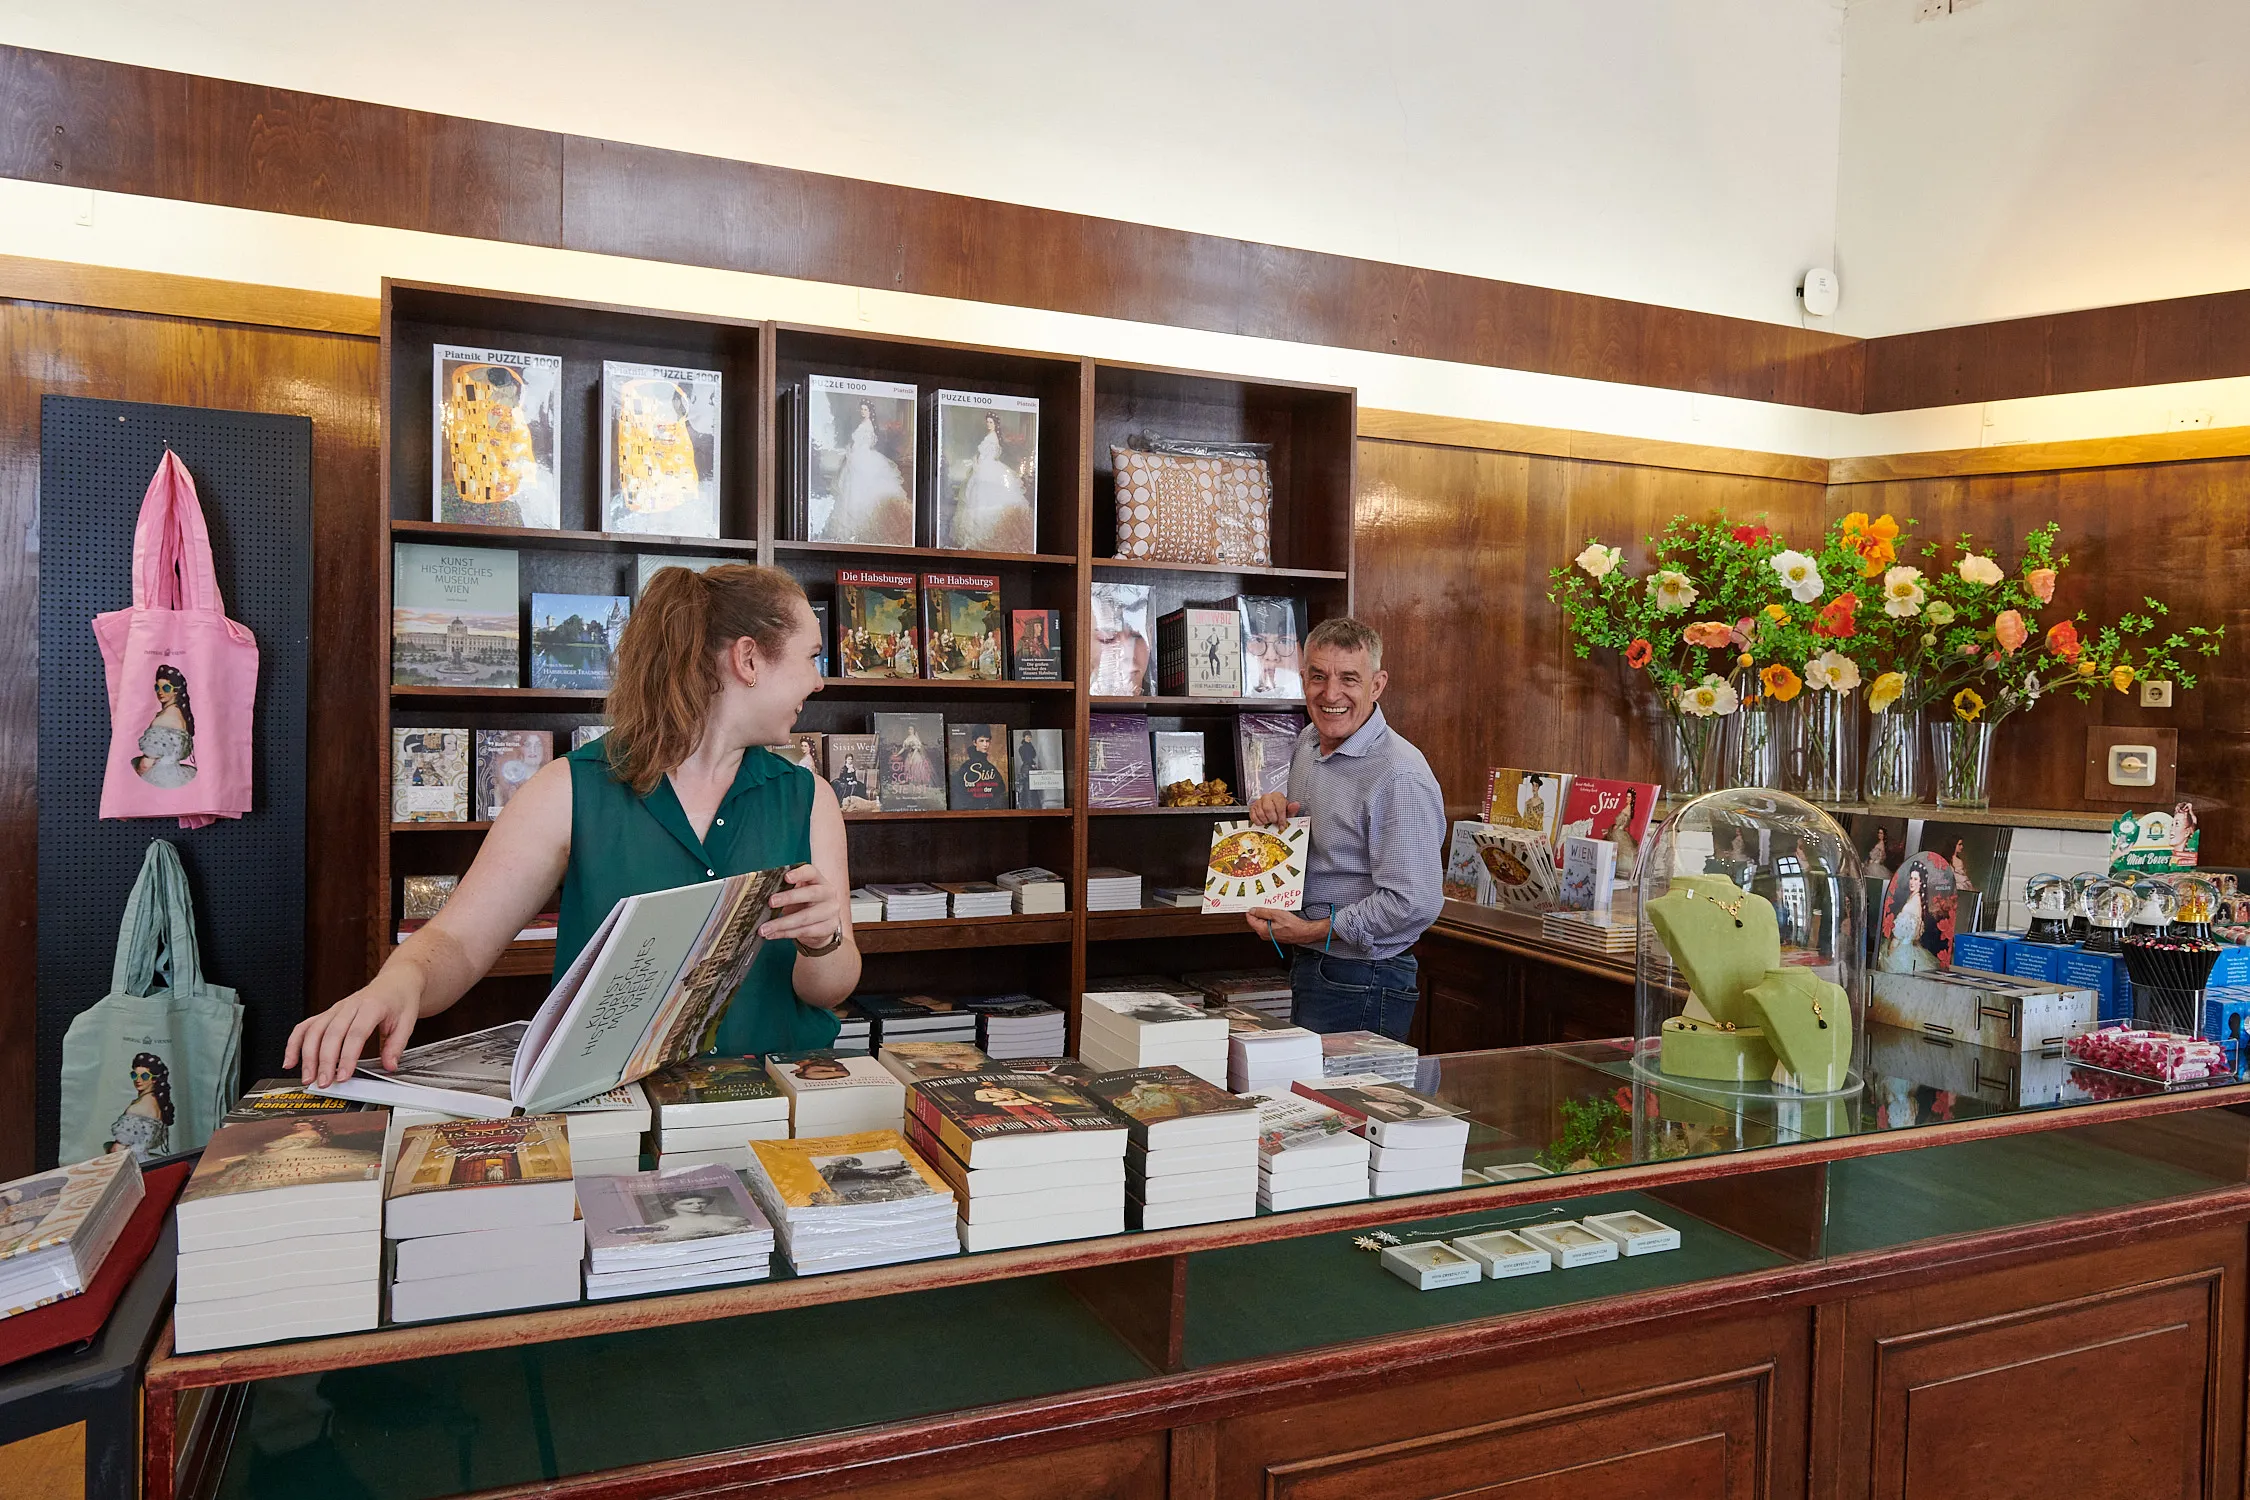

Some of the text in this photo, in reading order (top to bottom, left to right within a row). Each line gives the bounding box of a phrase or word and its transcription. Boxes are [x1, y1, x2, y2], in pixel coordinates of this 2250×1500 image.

[445, 350, 559, 368] Piatnik PUZZLE 1000
[653, 368, 693, 381] PUZZLE
[811, 379, 844, 390] PUZZLE
[847, 382, 867, 391] 1000
[941, 393, 971, 403] PUZZLE
[973, 396, 992, 405] 1000
[441, 556, 474, 567] KUNST
[421, 564, 493, 578] HISTORISCHES
[842, 571, 912, 585] Die Habsburger
[435, 574, 479, 586] MUSEUM
[928, 574, 993, 588] The Habsburgs
[444, 584, 470, 594] WIEN
[832, 742, 876, 753] Sisis Weg
[963, 762, 996, 783] Sisi
[1589, 791, 1622, 815] Sisi
[1571, 844, 1595, 860] WIEN
[2126, 853, 2147, 866] Mint
[2147, 852, 2170, 865] Boxes
[1264, 889, 1302, 905] INSPIRED
[1284, 899, 1296, 908] BY
[580, 937, 656, 1057] HISTORISCHES
[607, 957, 656, 1030] MUSEUM
[627, 970, 659, 1013] WIEN
[585, 974, 624, 1029] KUNST
[923, 1077, 967, 1089] TWILIGHT
[731, 1089, 772, 1097] Maria
